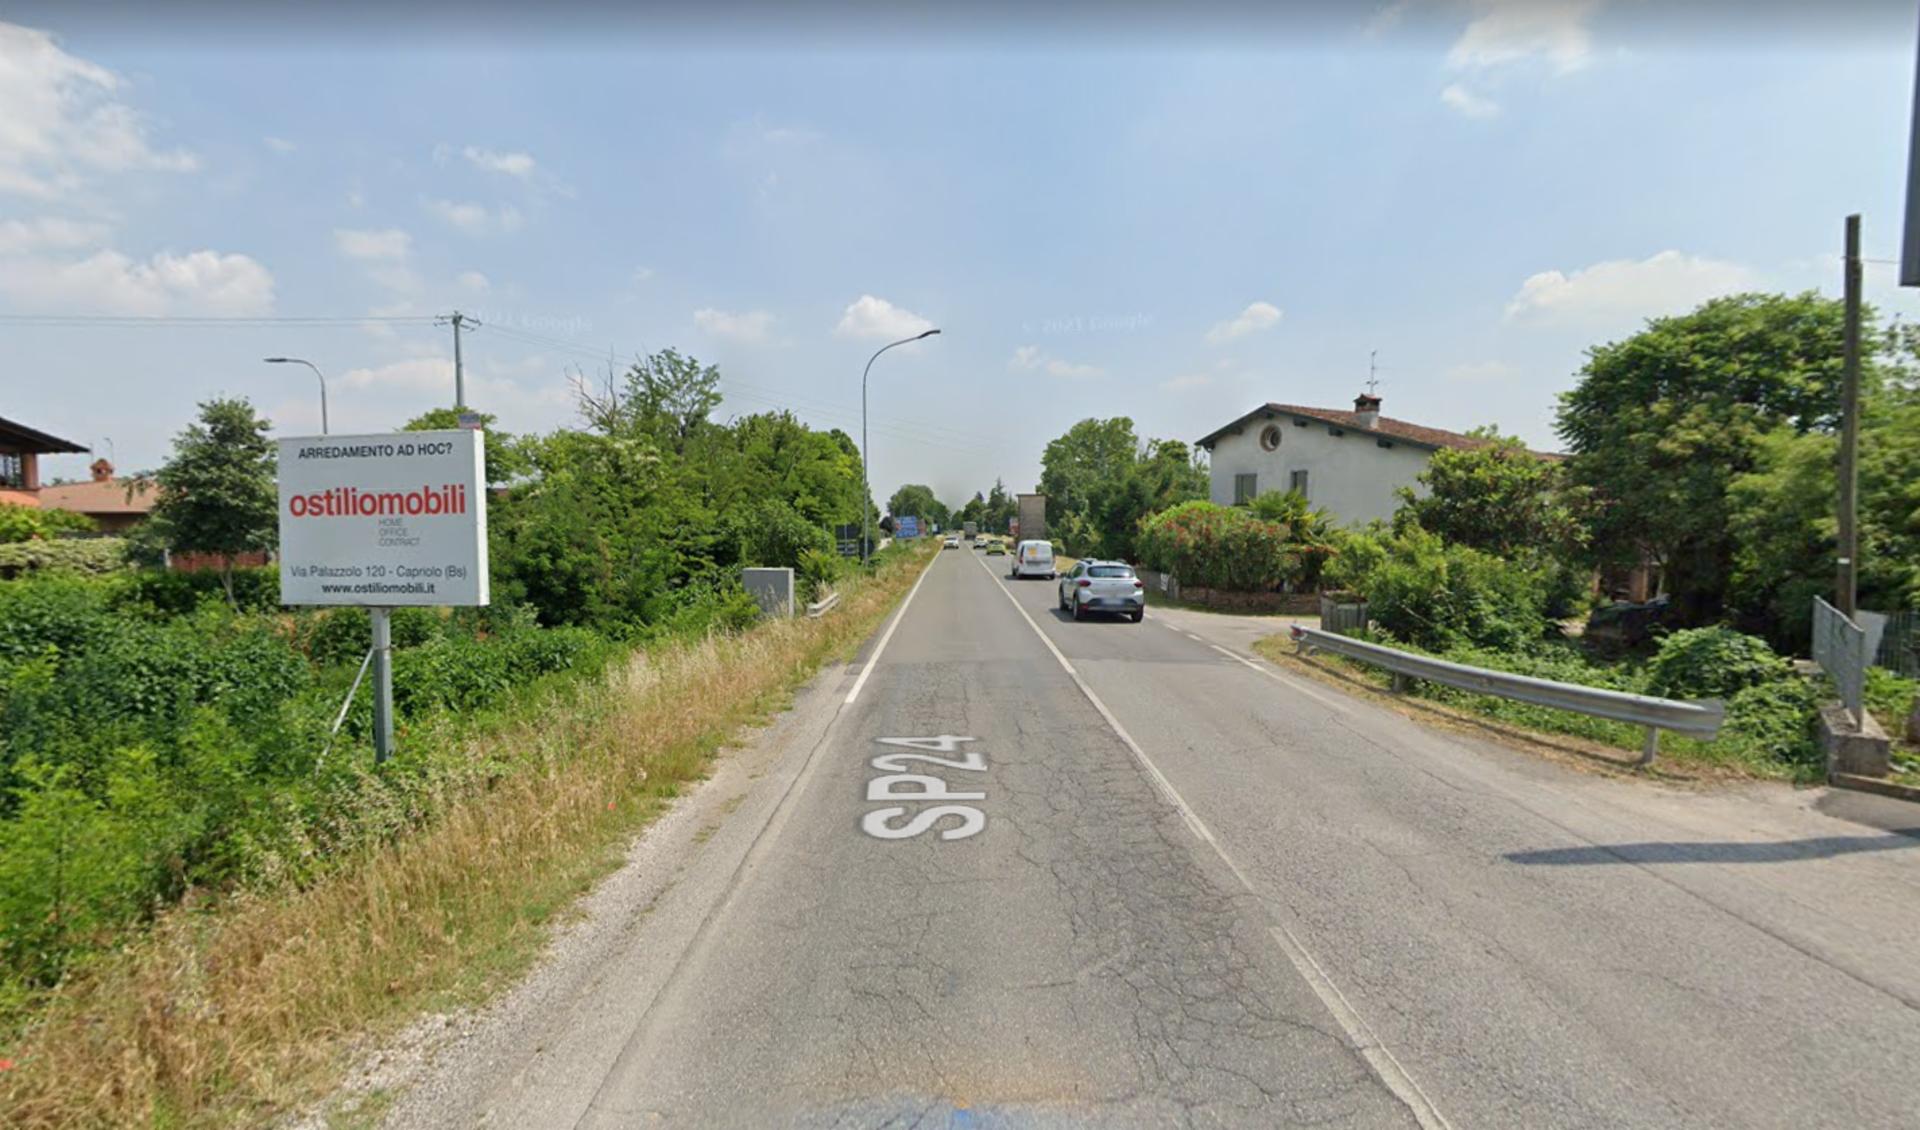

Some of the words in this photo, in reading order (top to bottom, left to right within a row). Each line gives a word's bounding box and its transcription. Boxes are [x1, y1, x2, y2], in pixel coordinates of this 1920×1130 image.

[299, 446, 393, 459] ARREDAMENTO
[397, 444, 415, 456] AD
[418, 443, 453, 455] HOC?
[289, 484, 466, 516] ostiliomobili
[378, 518, 402, 526] HOME
[378, 528, 408, 537] OFFICE
[378, 537, 420, 546] CONTRACT
[291, 566, 307, 577] Via
[310, 566, 362, 577] Palazzolo
[366, 566, 386, 577] 120
[396, 566, 443, 579] Capriolo
[445, 565, 467, 580] (Bs)
[322, 583, 435, 594] www.ostiliomobili.it
